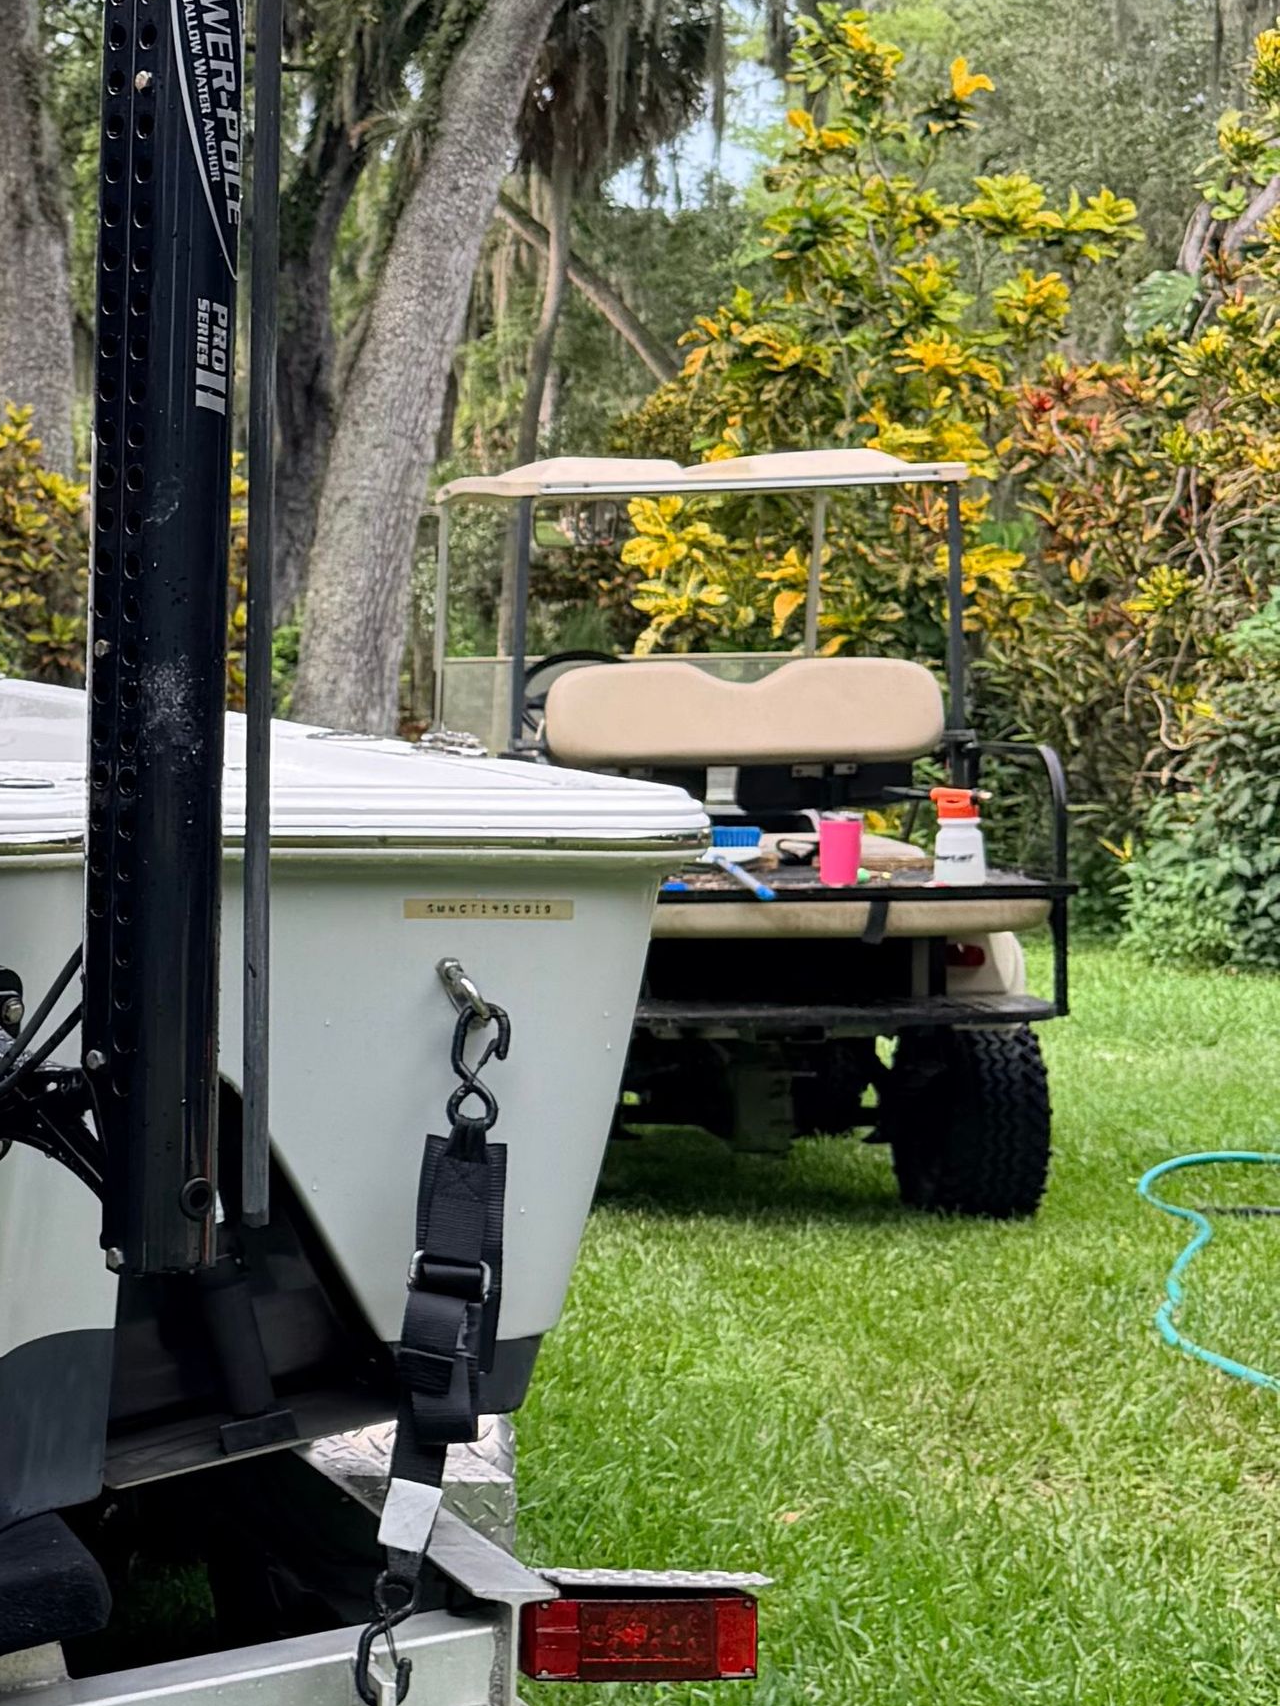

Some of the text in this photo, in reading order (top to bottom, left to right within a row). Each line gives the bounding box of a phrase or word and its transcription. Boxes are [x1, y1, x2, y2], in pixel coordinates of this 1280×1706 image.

[193, 57, 212, 114] WATER
[202, 117, 221, 183] ANCHOR
[197, 297, 211, 366] SERIES
[211, 302, 229, 372] PRO
